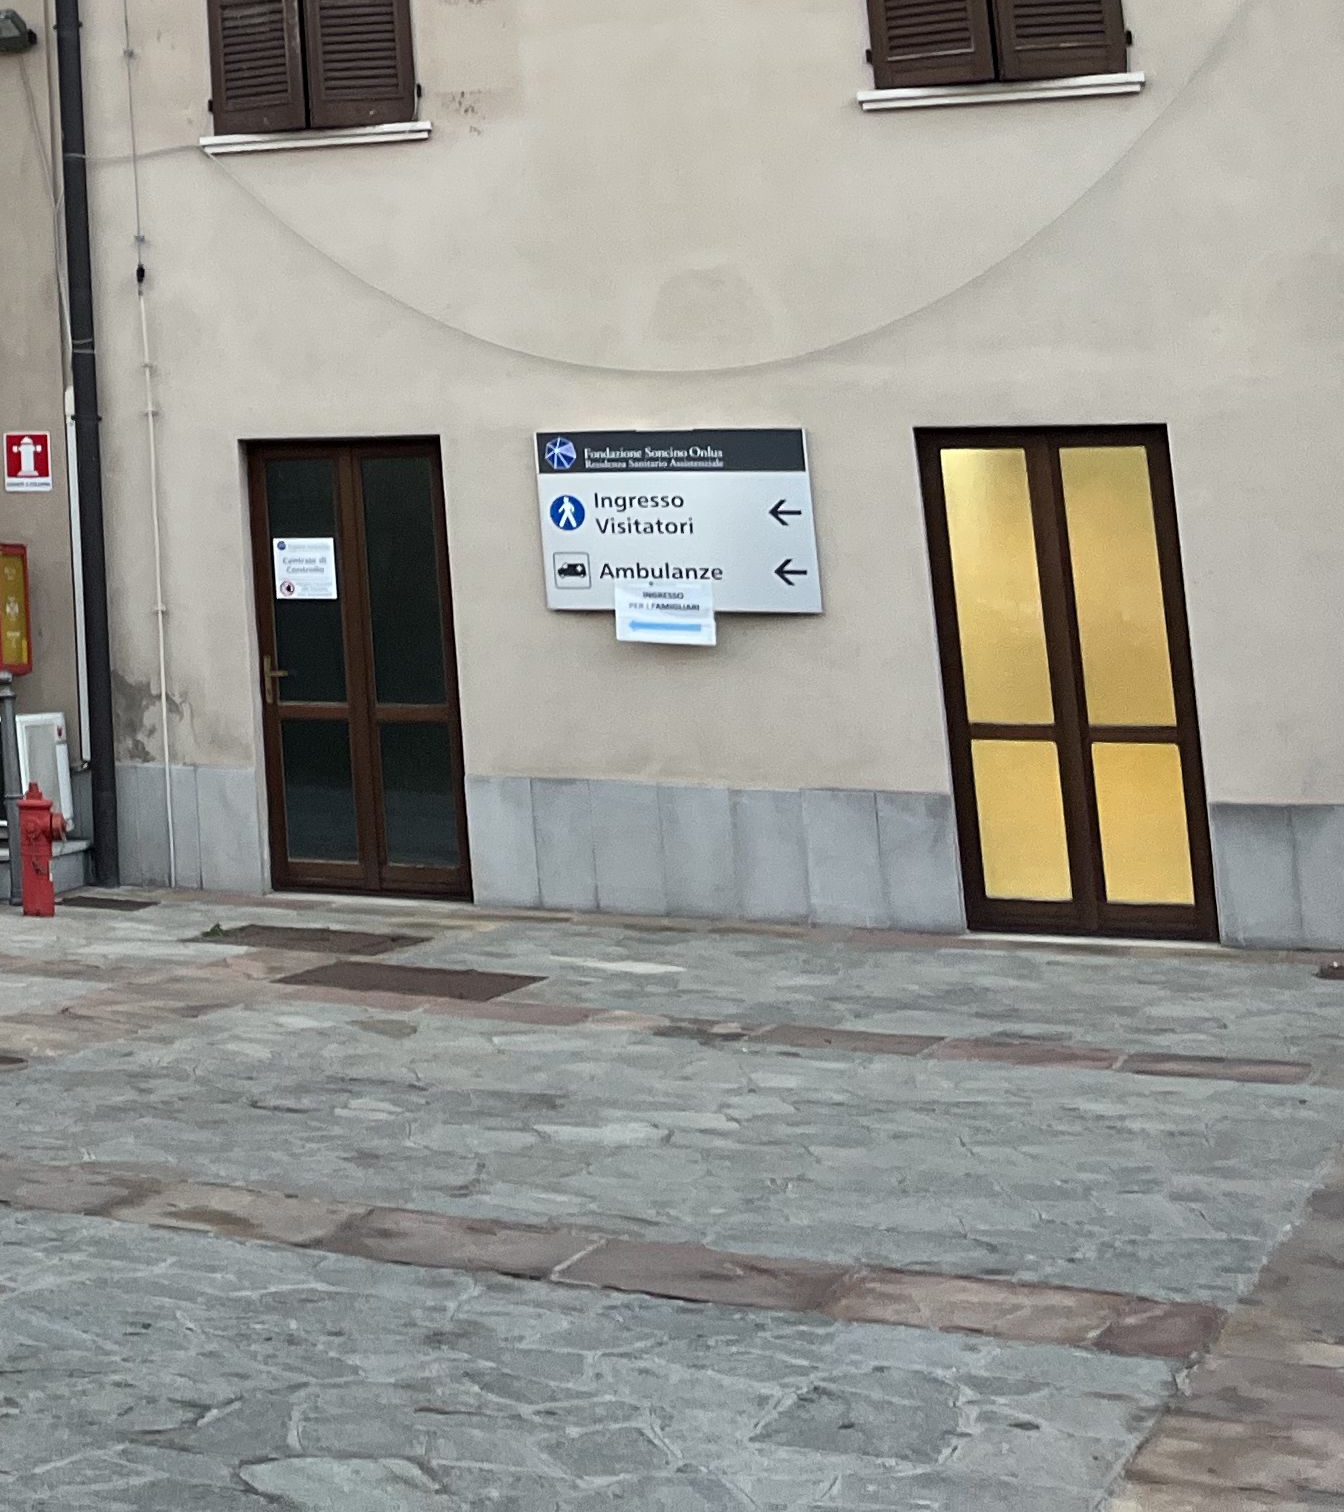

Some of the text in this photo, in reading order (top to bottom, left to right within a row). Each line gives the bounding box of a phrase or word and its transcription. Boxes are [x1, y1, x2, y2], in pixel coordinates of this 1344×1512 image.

[584, 446, 723, 459] Fondazione Soncino Onlus
[594, 492, 685, 513] Ingresso
[595, 516, 694, 535] Visitatori
[599, 562, 724, 580] Ambulanze
[642, 591, 684, 600] INGRESSO
